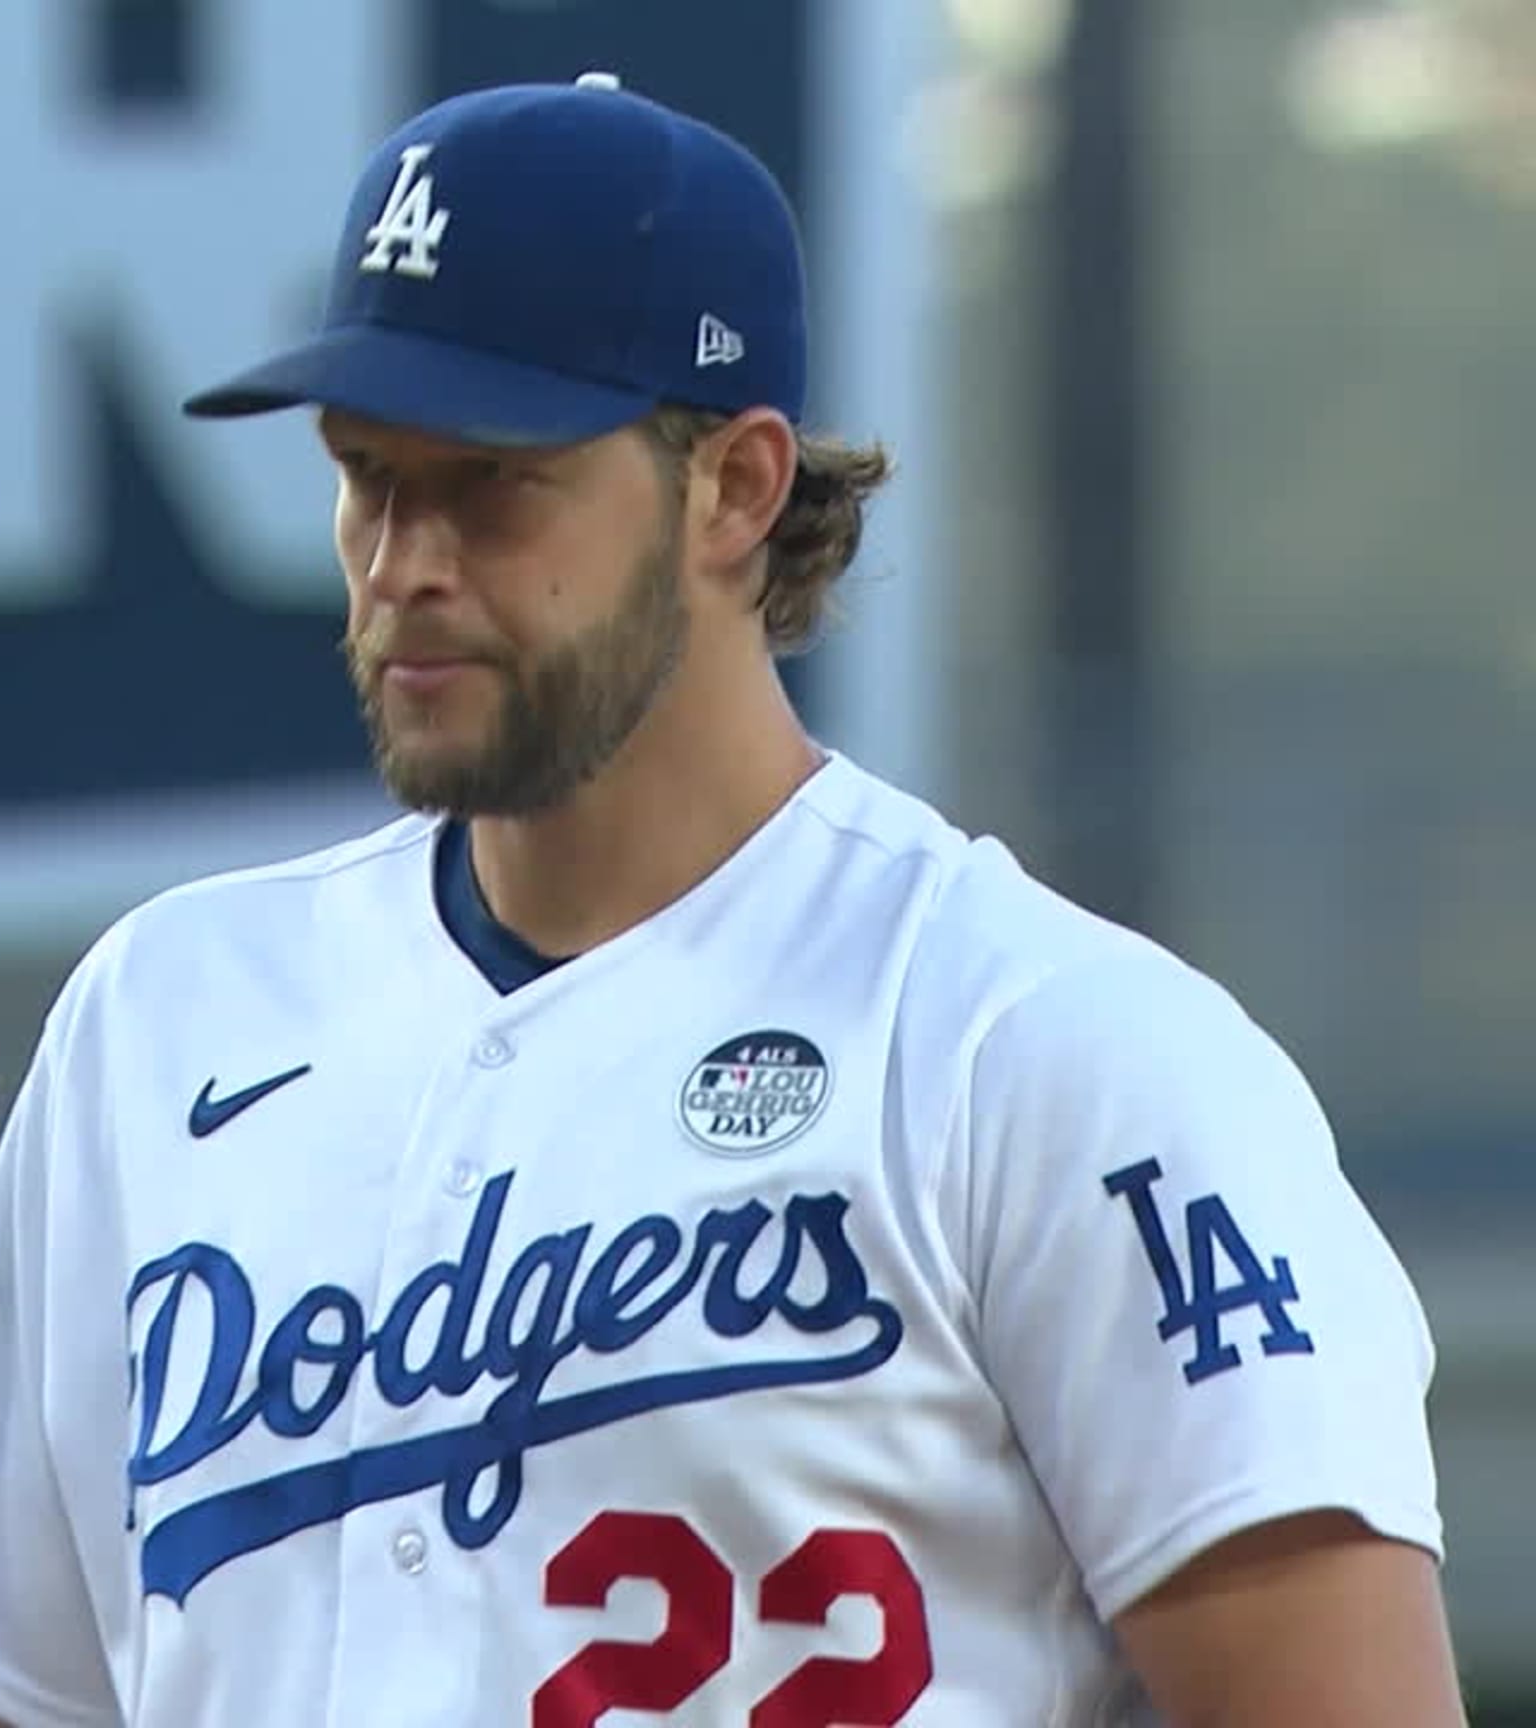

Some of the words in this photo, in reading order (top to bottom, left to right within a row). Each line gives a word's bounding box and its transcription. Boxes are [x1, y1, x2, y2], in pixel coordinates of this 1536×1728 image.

[360, 144, 450, 279] LA
[687, 1091, 813, 1116] GEHRIG
[706, 1114, 779, 1138] DAY
[751, 1069, 818, 1093] LOU
[1101, 1155, 1316, 1387] LA
[126, 1169, 888, 1550] Dodgers
[530, 1509, 934, 1728] 22
